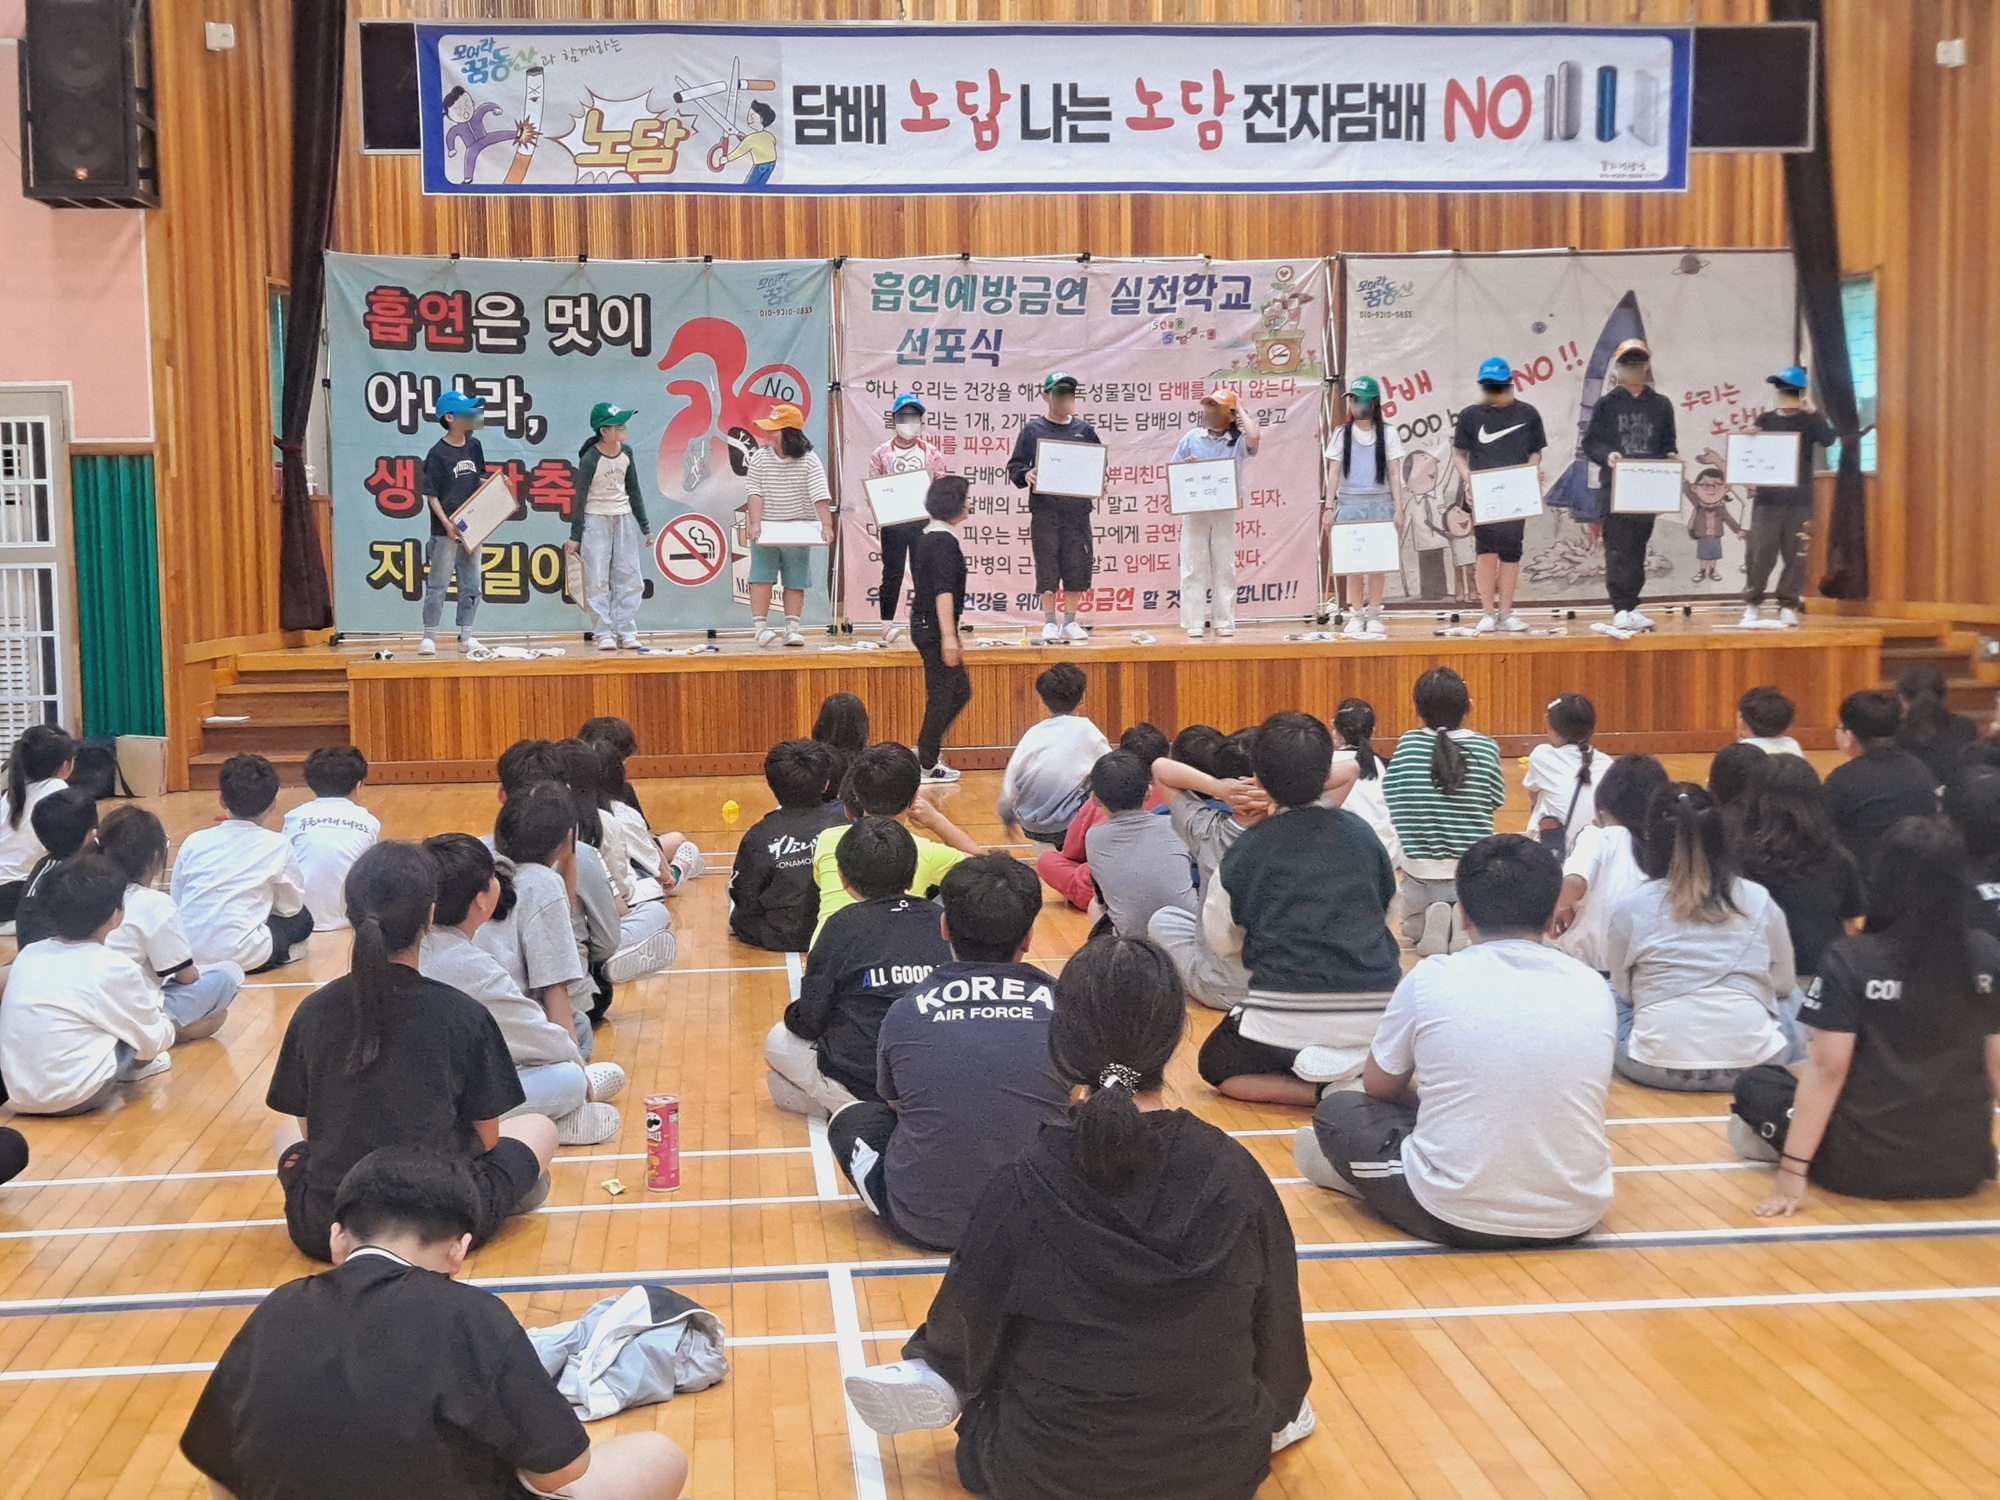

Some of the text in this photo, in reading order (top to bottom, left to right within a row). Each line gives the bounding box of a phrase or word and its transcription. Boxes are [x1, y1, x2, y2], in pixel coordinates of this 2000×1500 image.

[792, 68, 1532, 152] 담배 노담 나는 노담 전자담배 NO
[573, 108, 692, 175] 노담
[870, 271, 1253, 316] 흡연예방금연 실천학교
[366, 288, 647, 352] 흡연은 멋이
[895, 327, 1004, 368] 선포식
[1511, 355, 1554, 393] NO
[763, 376, 795, 402] No
[909, 380, 958, 401] 우리는
[964, 381, 1012, 402] 건강을
[1158, 380, 1206, 401] 담배를
[1248, 378, 1301, 399] 않는다.
[1680, 382, 1741, 411] 우리는
[920, 411, 958, 431] 리는
[1135, 410, 1182, 432] 담배의
[1257, 407, 1287, 427] 알고
[1397, 414, 1442, 444] OOD
[1107, 495, 1138, 515] 말고
[963, 525, 1011, 546] 피우는
[1124, 553, 1172, 574] 입에도
[862, 967, 889, 989] ALL
[915, 976, 1054, 1015] KOREA
[932, 1006, 1034, 1023] AIR FORCE
